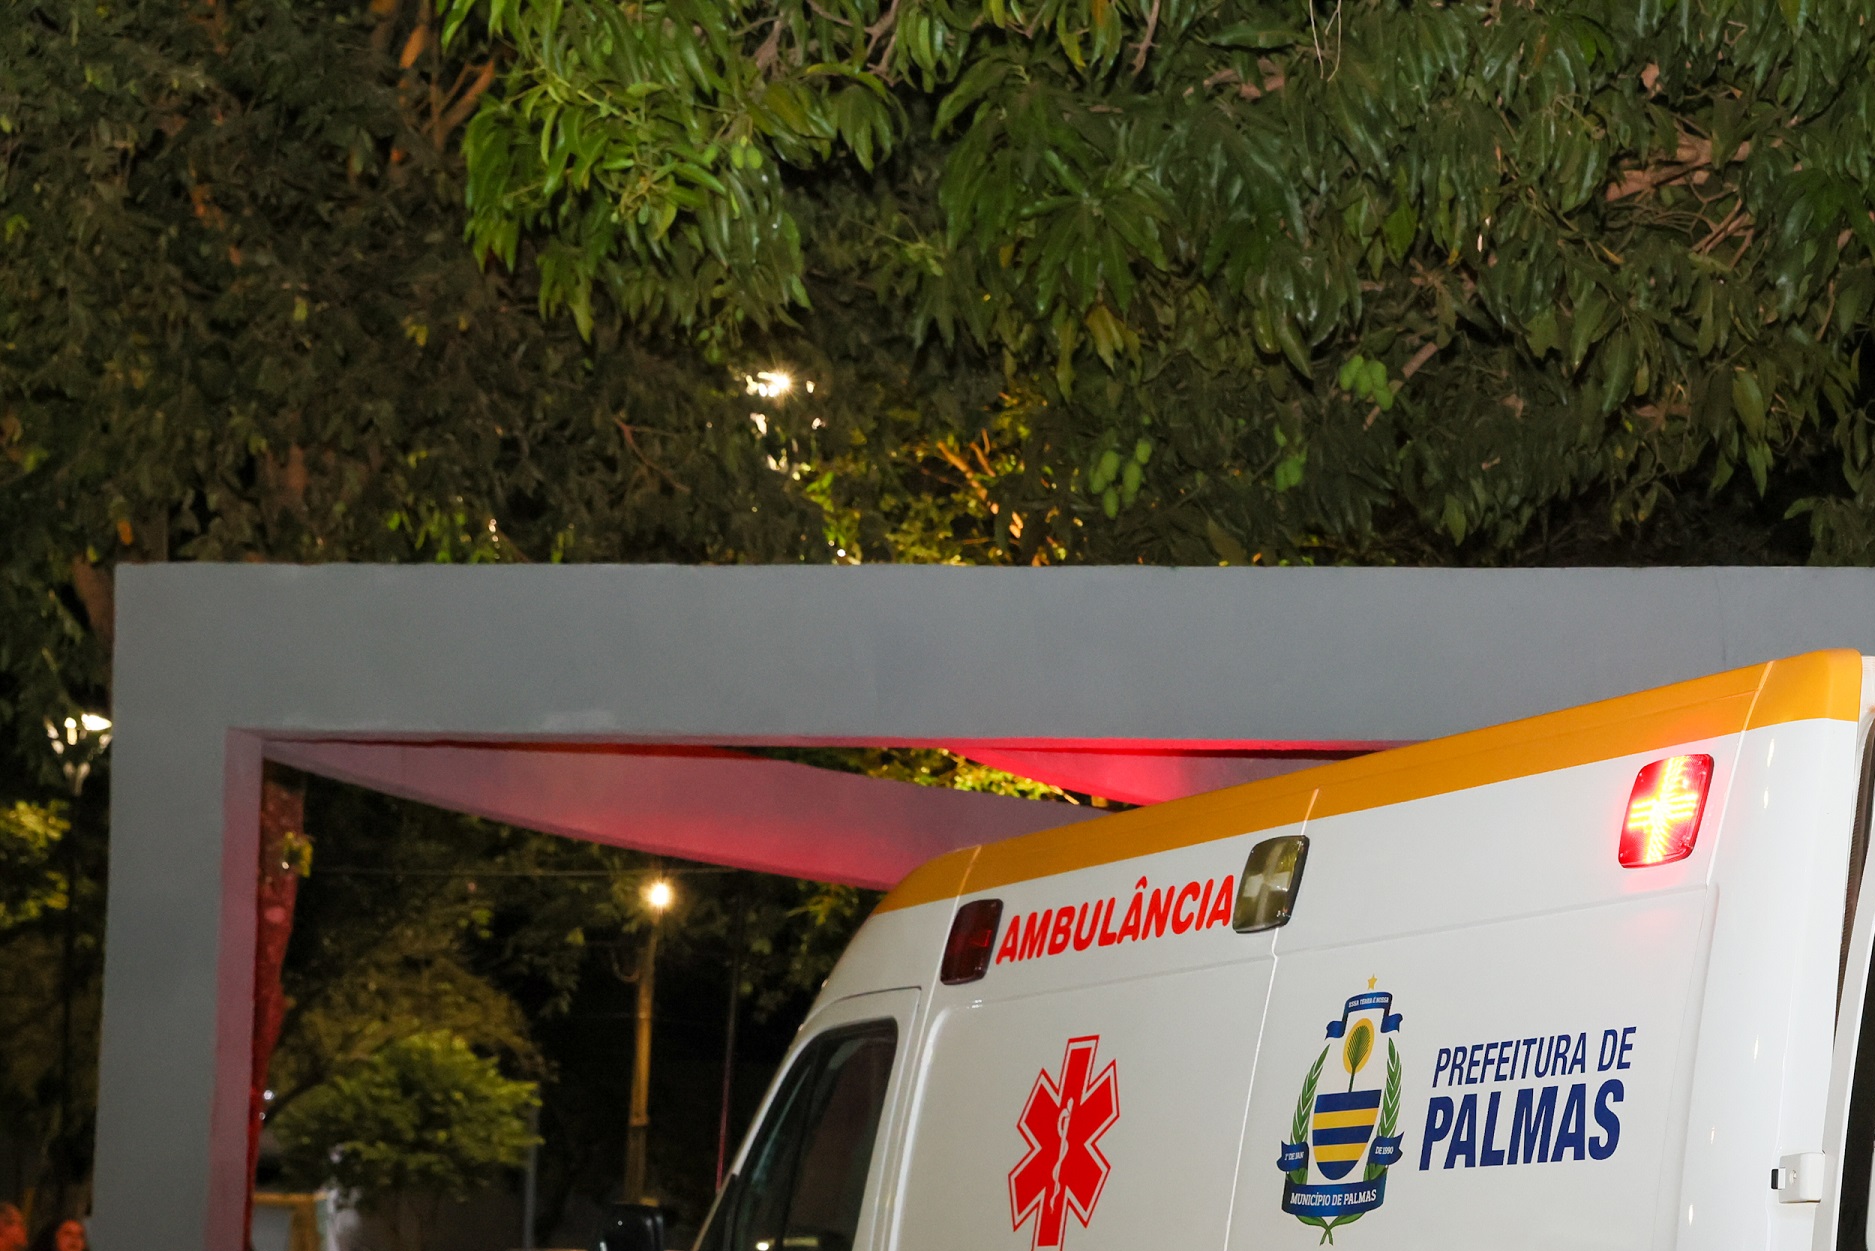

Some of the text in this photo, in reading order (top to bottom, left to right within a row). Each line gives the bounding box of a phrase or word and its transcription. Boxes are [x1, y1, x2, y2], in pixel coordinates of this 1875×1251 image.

[996, 875, 1234, 965] AMBULÂNCIA
[1432, 1026, 1637, 1088] PREFEITURA DE
[1375, 1146, 1383, 1154] DE
[1418, 1079, 1624, 1171] PALMAS
[1290, 1189, 1377, 1206] MUNICÍPIO DE PALMAS
